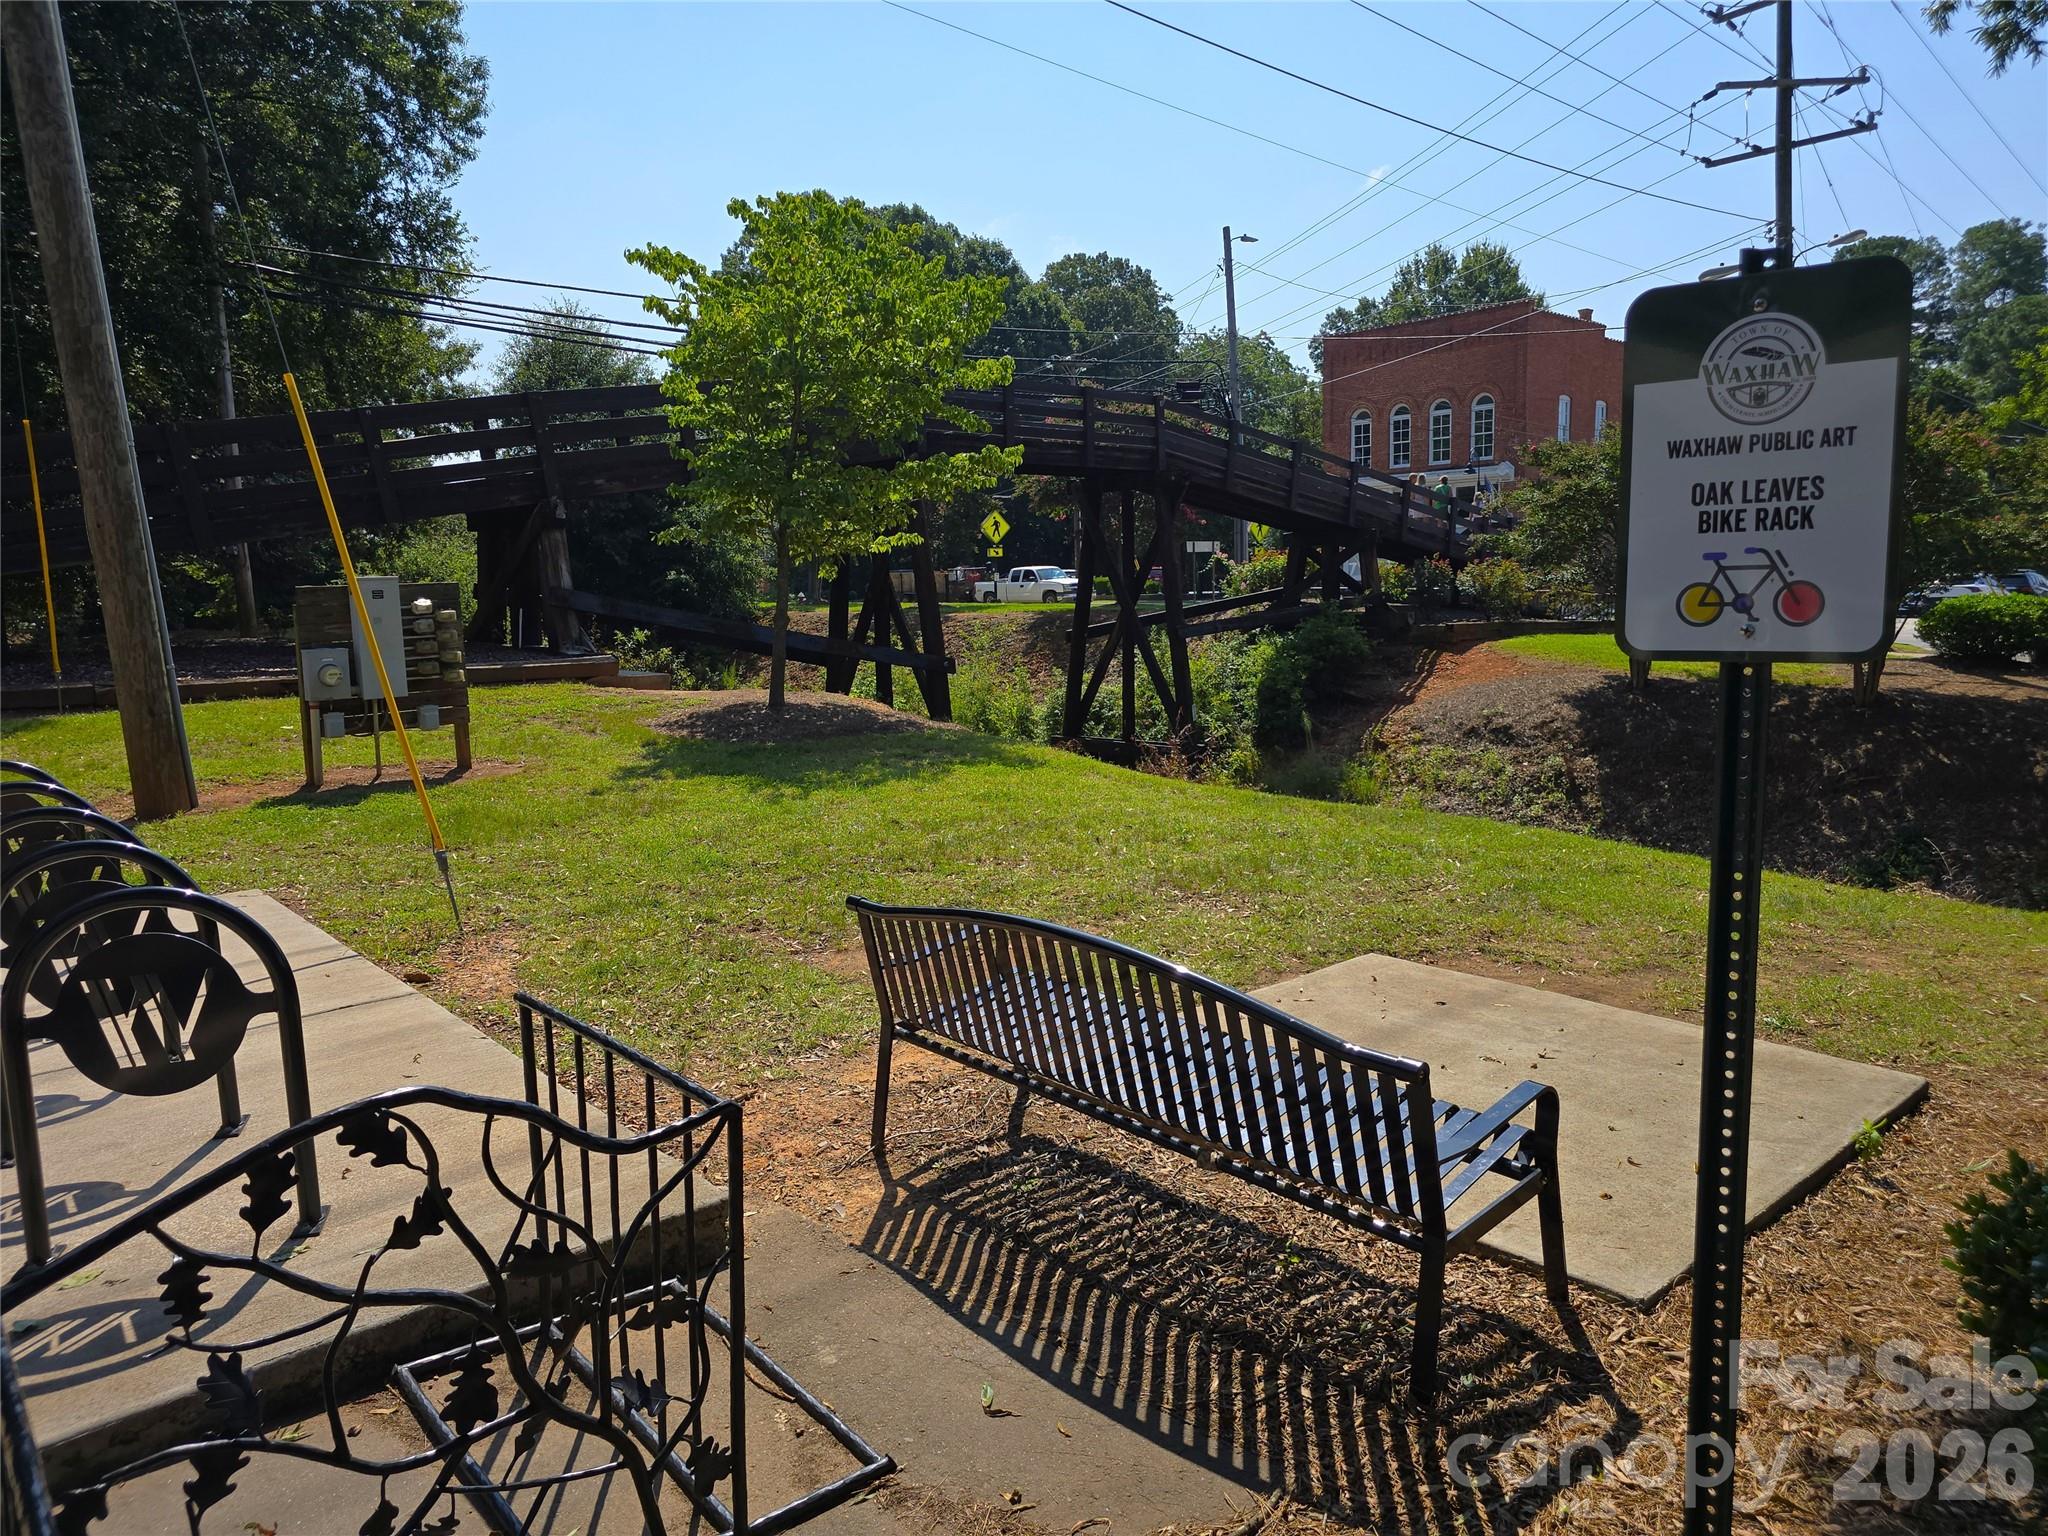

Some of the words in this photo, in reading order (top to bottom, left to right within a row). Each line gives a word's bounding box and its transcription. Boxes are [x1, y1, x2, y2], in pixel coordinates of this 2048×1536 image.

[1730, 324, 1769, 345] TOWN
[1774, 326, 1792, 337] OF
[1702, 351, 1821, 386] WAXHAW
[1667, 435, 1743, 459] WAXHAW
[1749, 429, 1814, 454] PUBLIC
[1820, 426, 1857, 448] ART
[1691, 480, 1735, 507] OAK
[1742, 475, 1825, 504] LEAVES
[1698, 508, 1747, 534] BIKE
[1755, 505, 1815, 532] RACK
